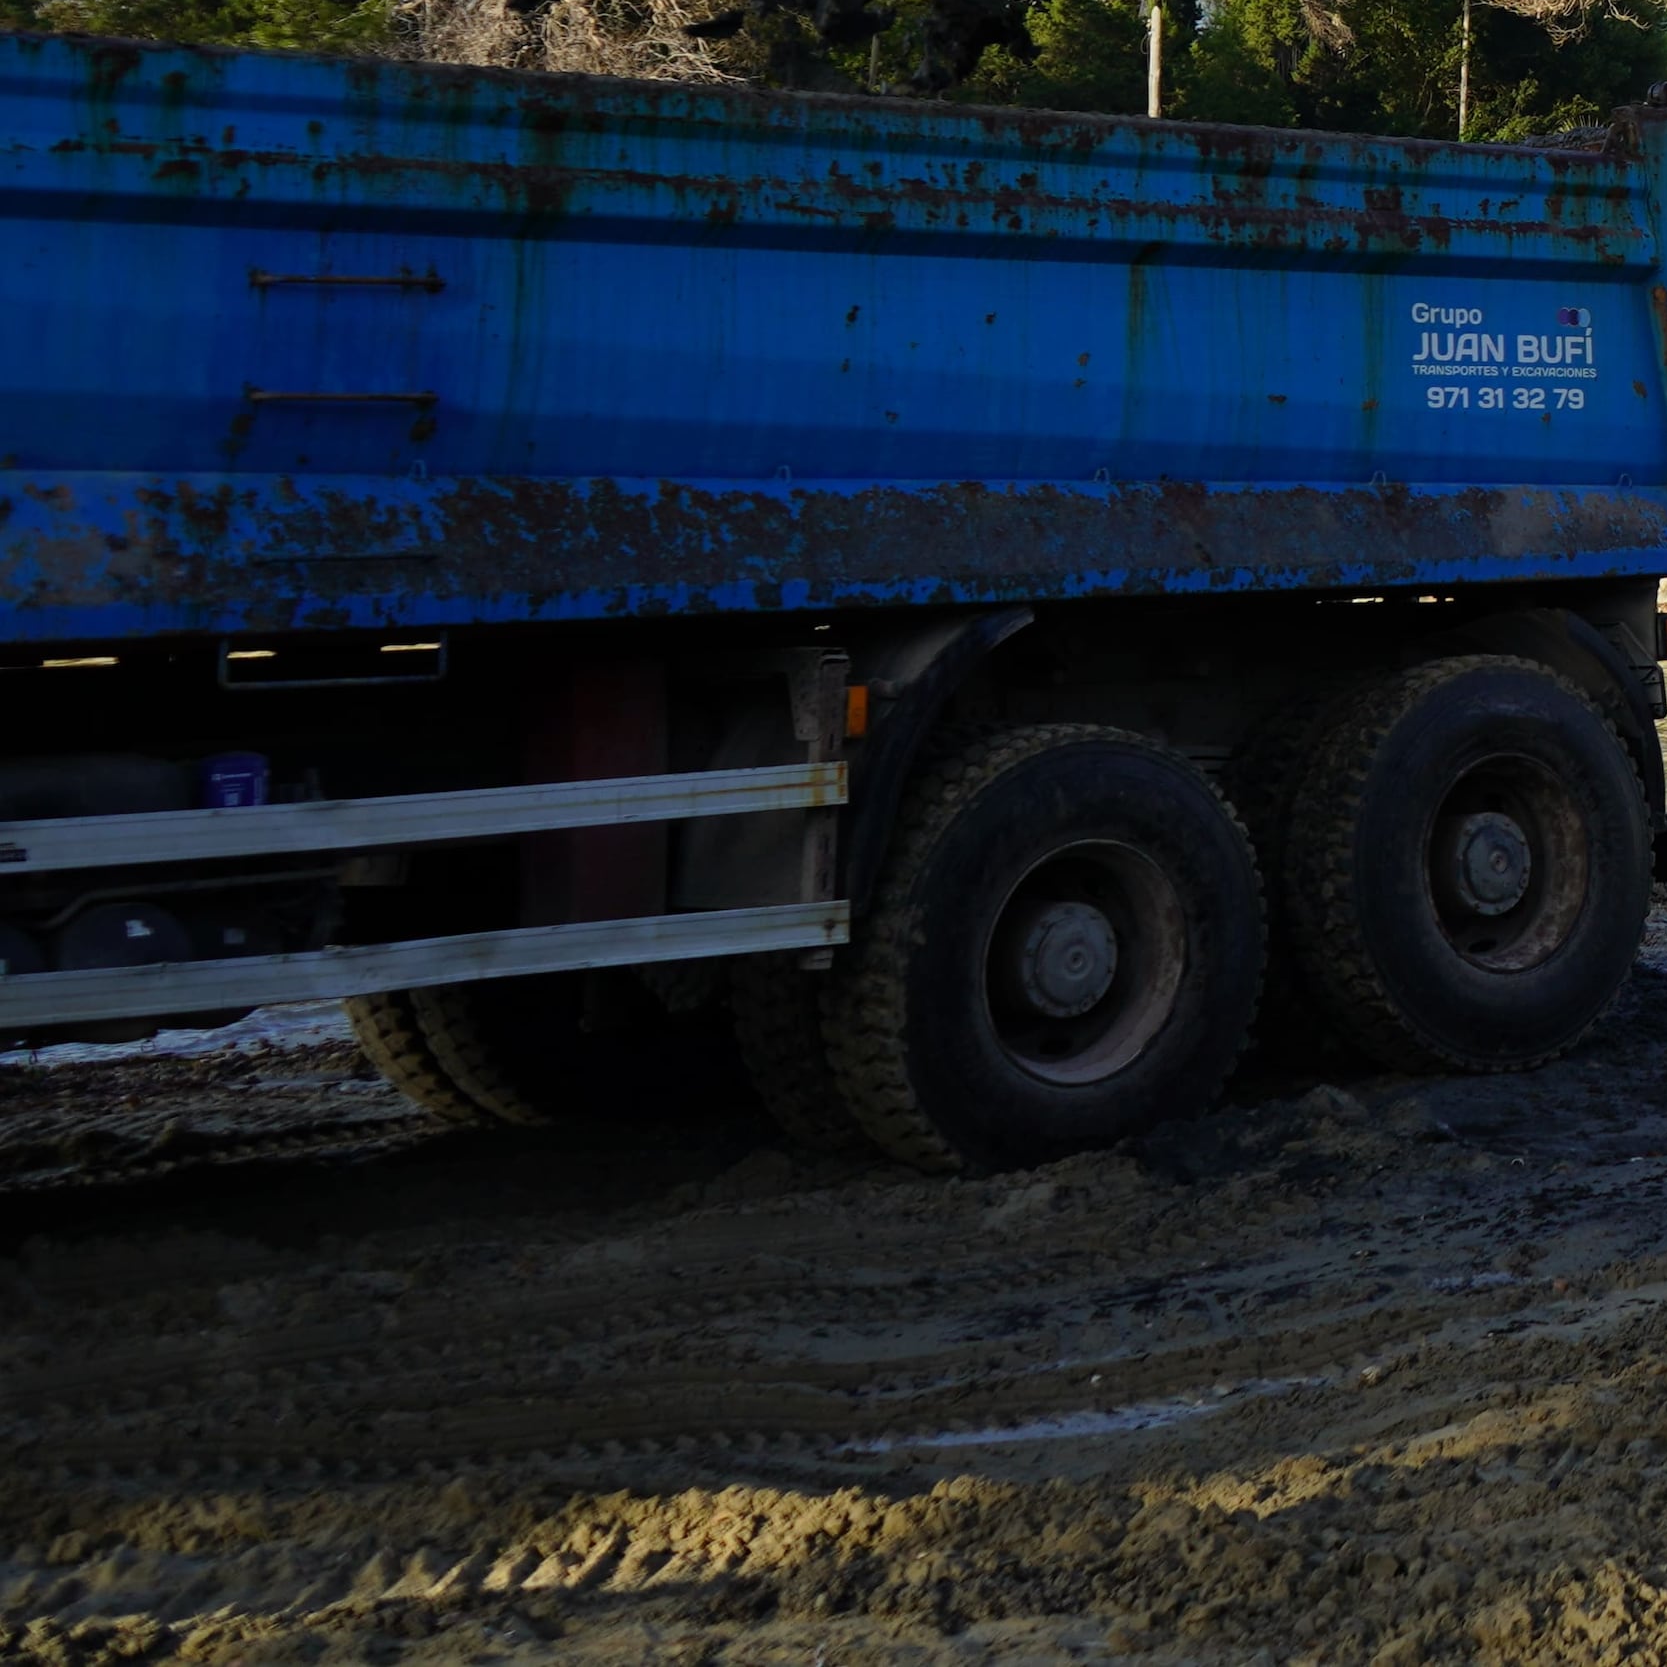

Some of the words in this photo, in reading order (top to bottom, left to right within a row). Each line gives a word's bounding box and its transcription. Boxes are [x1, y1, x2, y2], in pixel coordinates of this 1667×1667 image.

[1411, 302, 1482, 328] Grupo
[1412, 332, 1504, 362] JUAN
[1517, 328, 1593, 364] BUFÍ
[1411, 364, 1498, 376] TRANSPORTES
[1501, 366, 1510, 376] Y
[1512, 366, 1598, 378] EXCAVACIONES
[1427, 386, 1469, 408] 971
[1478, 387, 1504, 409] 31
[1512, 387, 1545, 409] 32
[1552, 388, 1585, 409] 79
